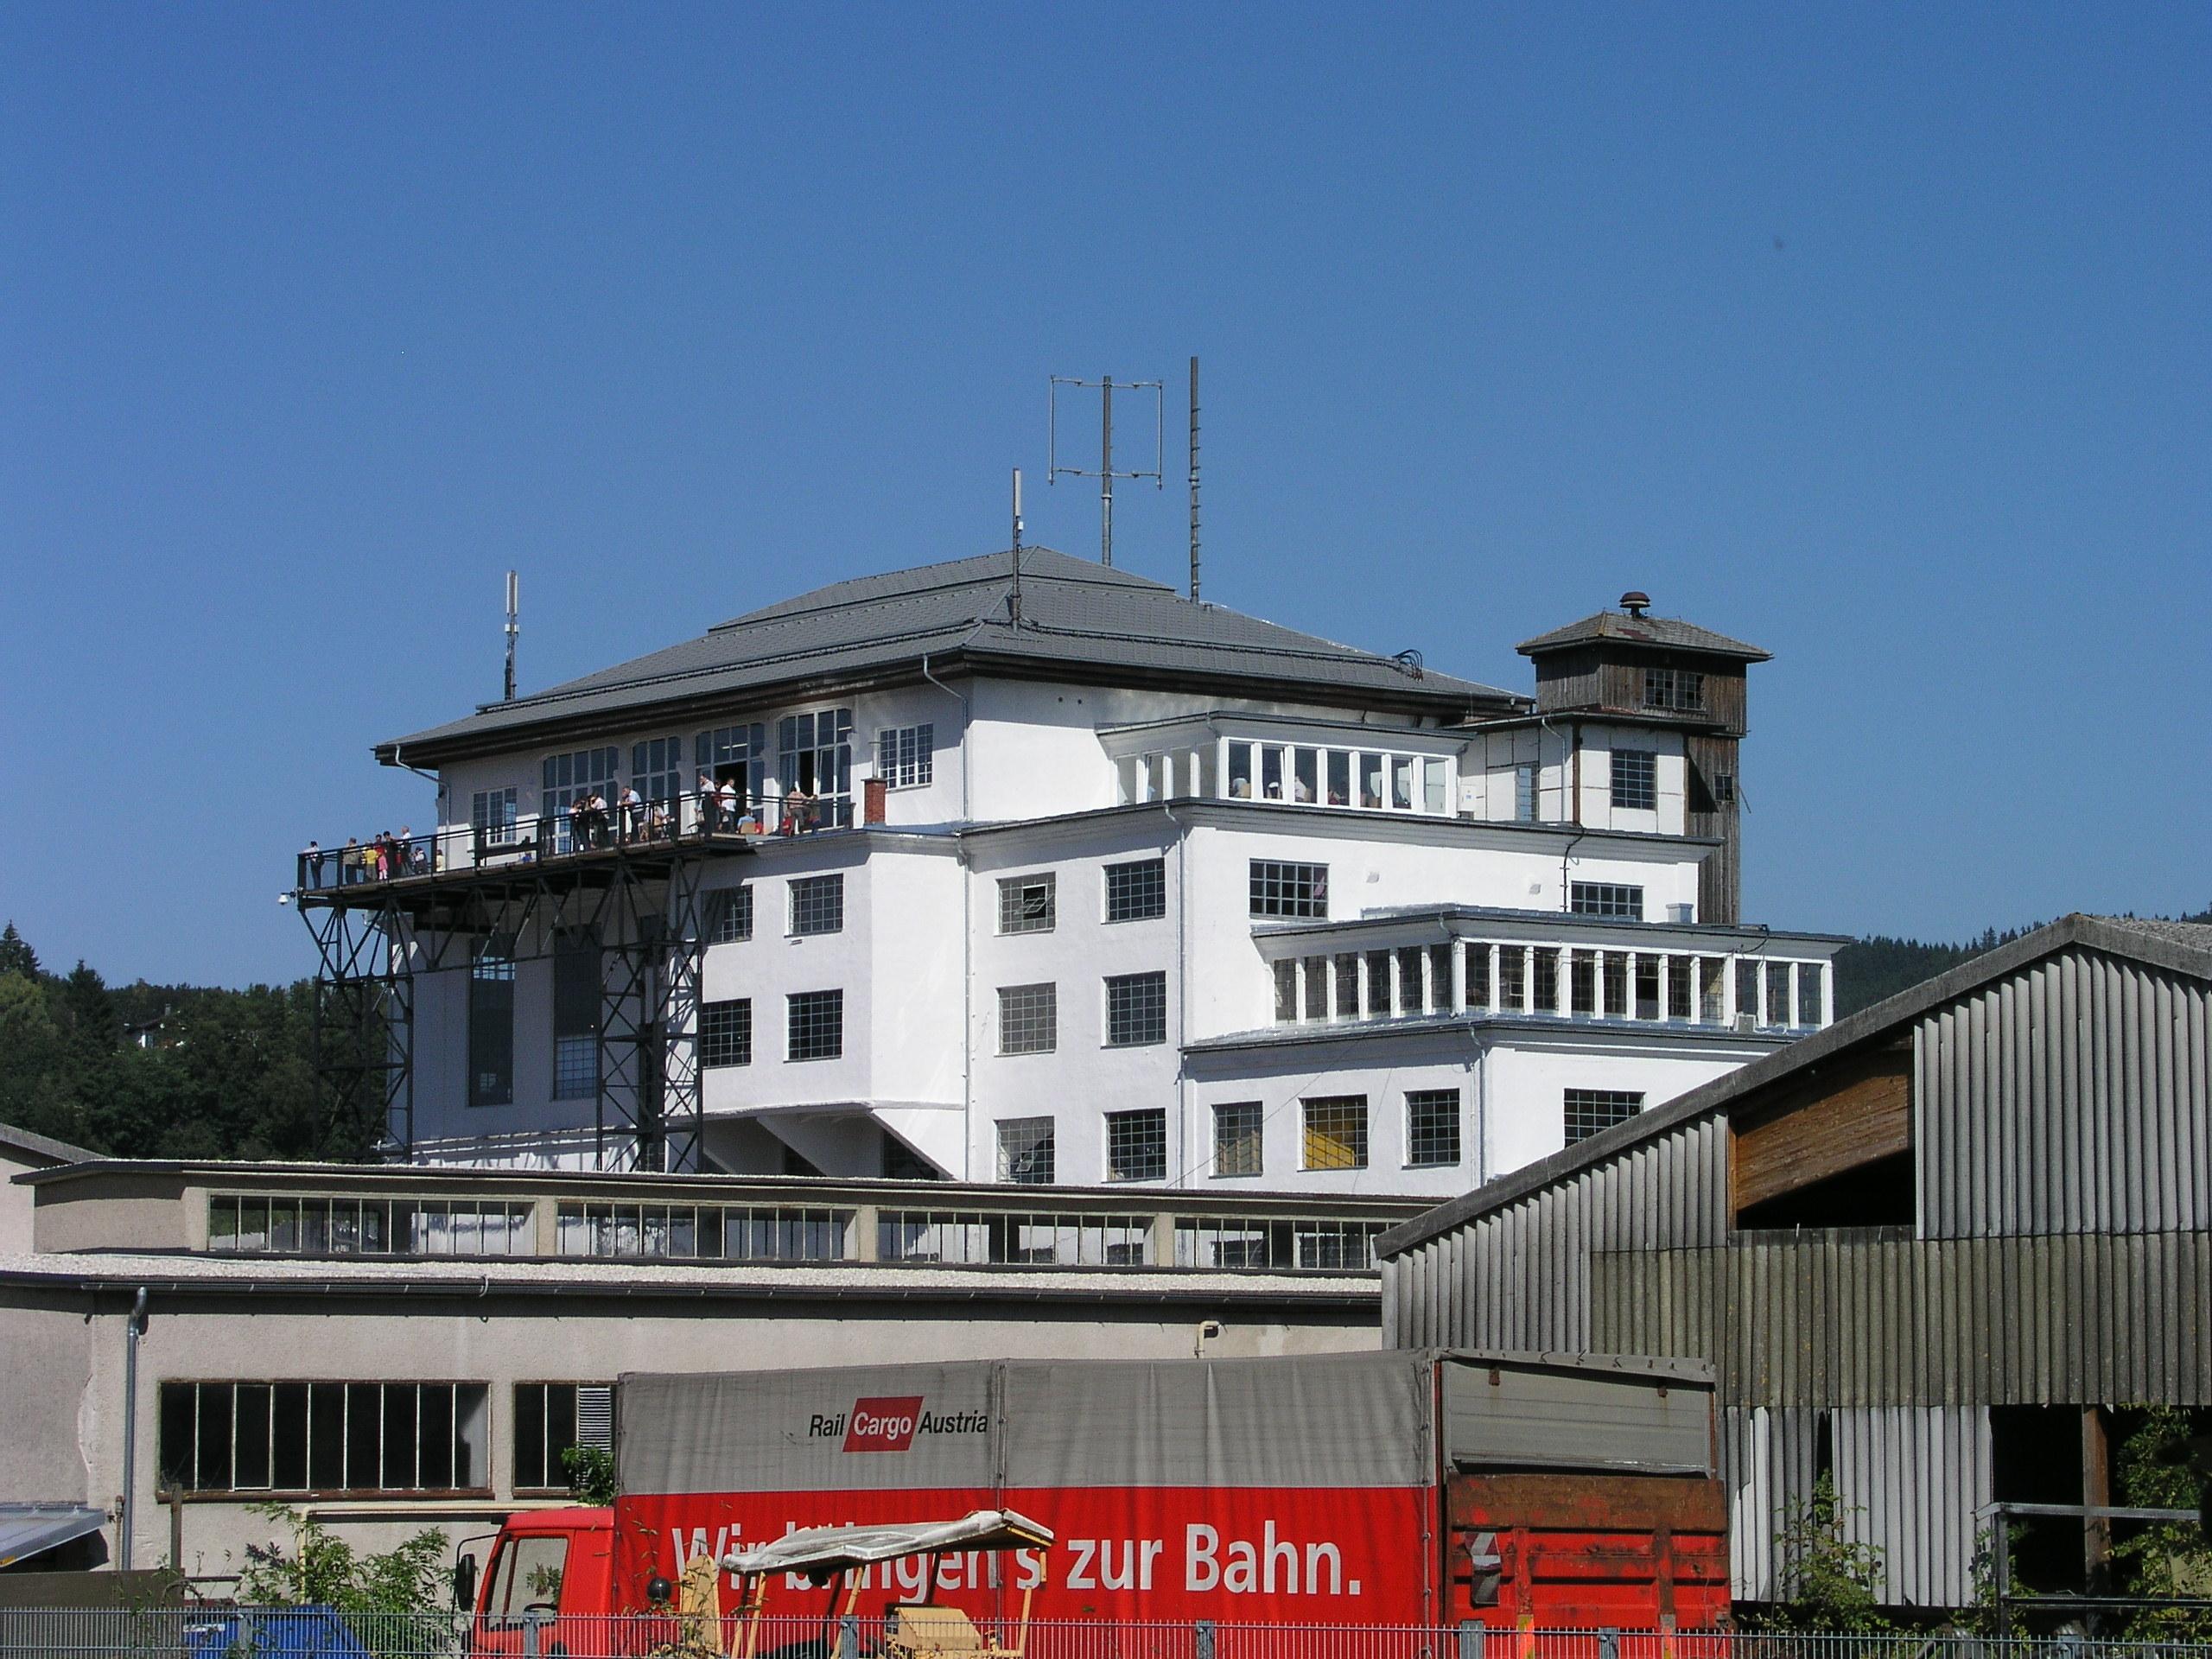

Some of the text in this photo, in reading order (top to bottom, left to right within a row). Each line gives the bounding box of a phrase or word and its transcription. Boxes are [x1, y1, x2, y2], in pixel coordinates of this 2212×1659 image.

[809, 1410, 988, 1440] Rail Cargo Austria
[1066, 1539, 1162, 1591] zur
[1185, 1520, 1362, 1595] Bahn.
